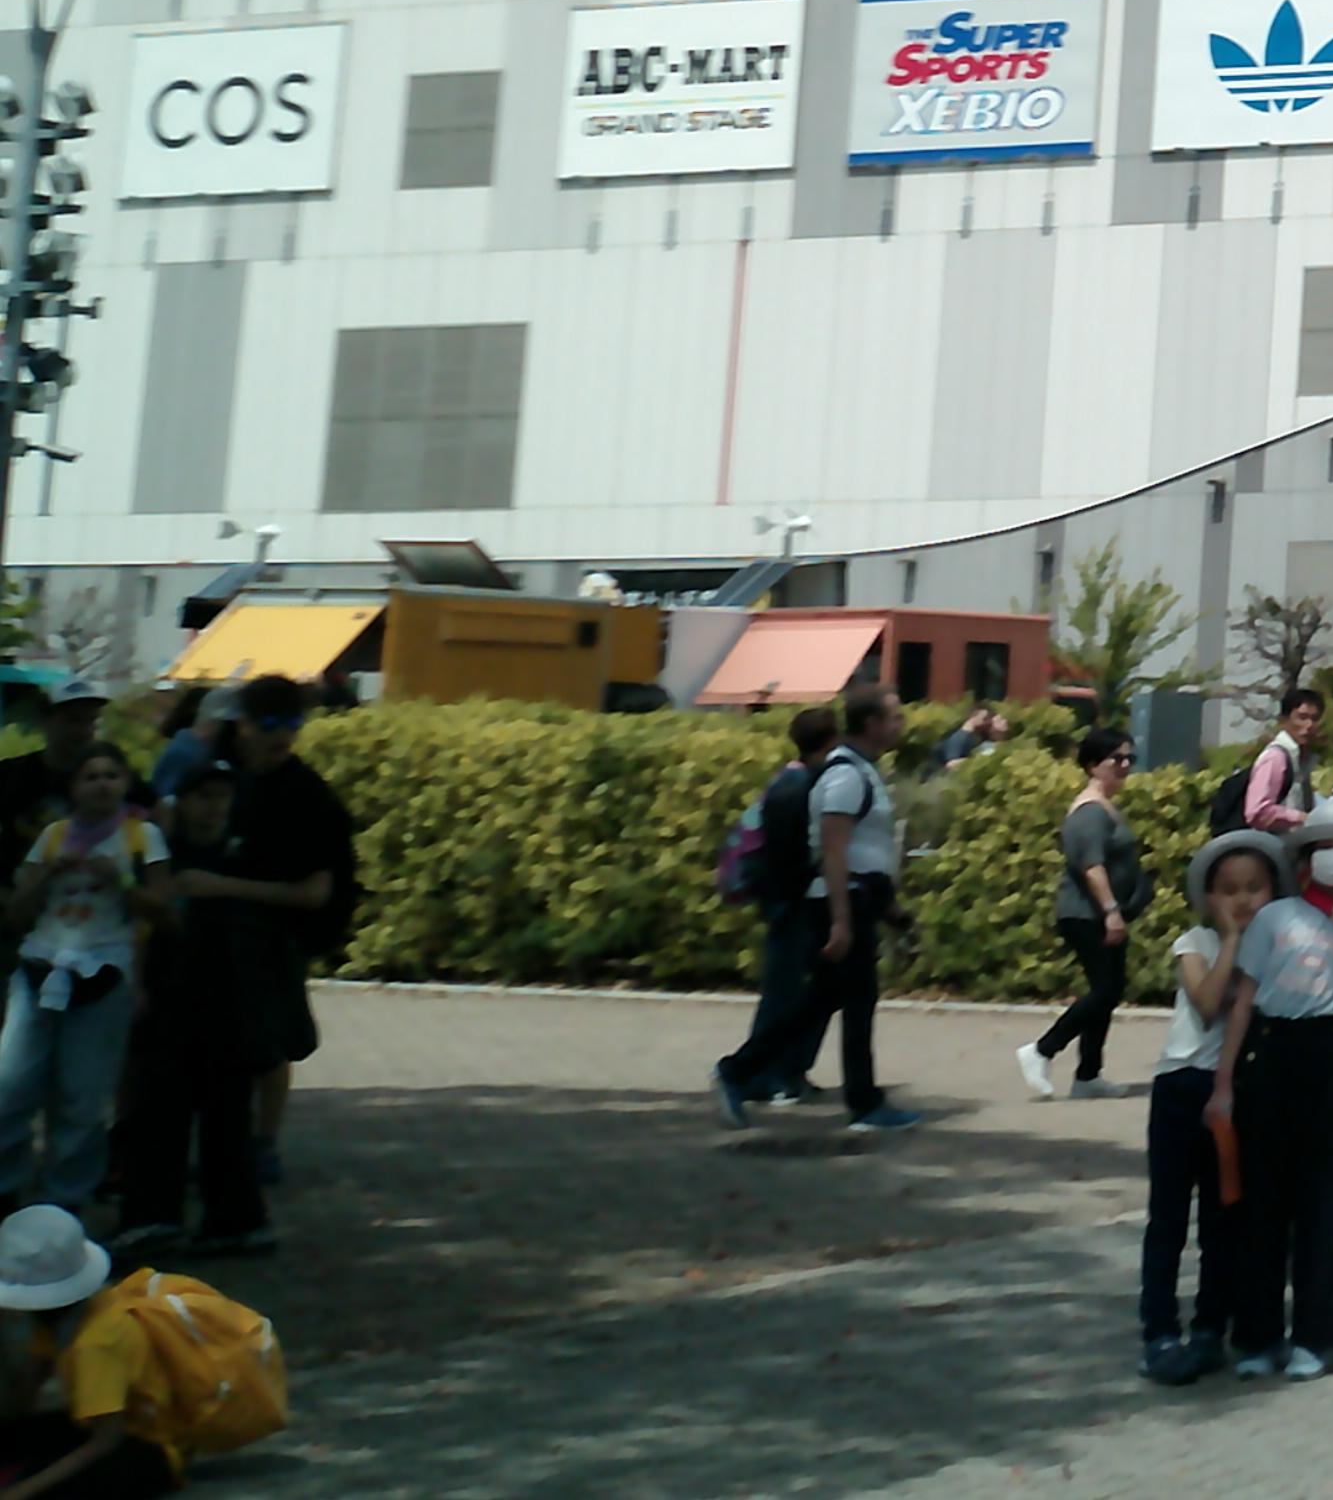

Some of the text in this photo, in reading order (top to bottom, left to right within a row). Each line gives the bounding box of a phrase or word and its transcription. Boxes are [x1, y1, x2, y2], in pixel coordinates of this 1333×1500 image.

[932, 11, 1069, 54] SUPER
[887, 43, 1051, 86] SPORTS
[149, 73, 312, 149] COS
[884, 85, 1066, 135] XEBIO
